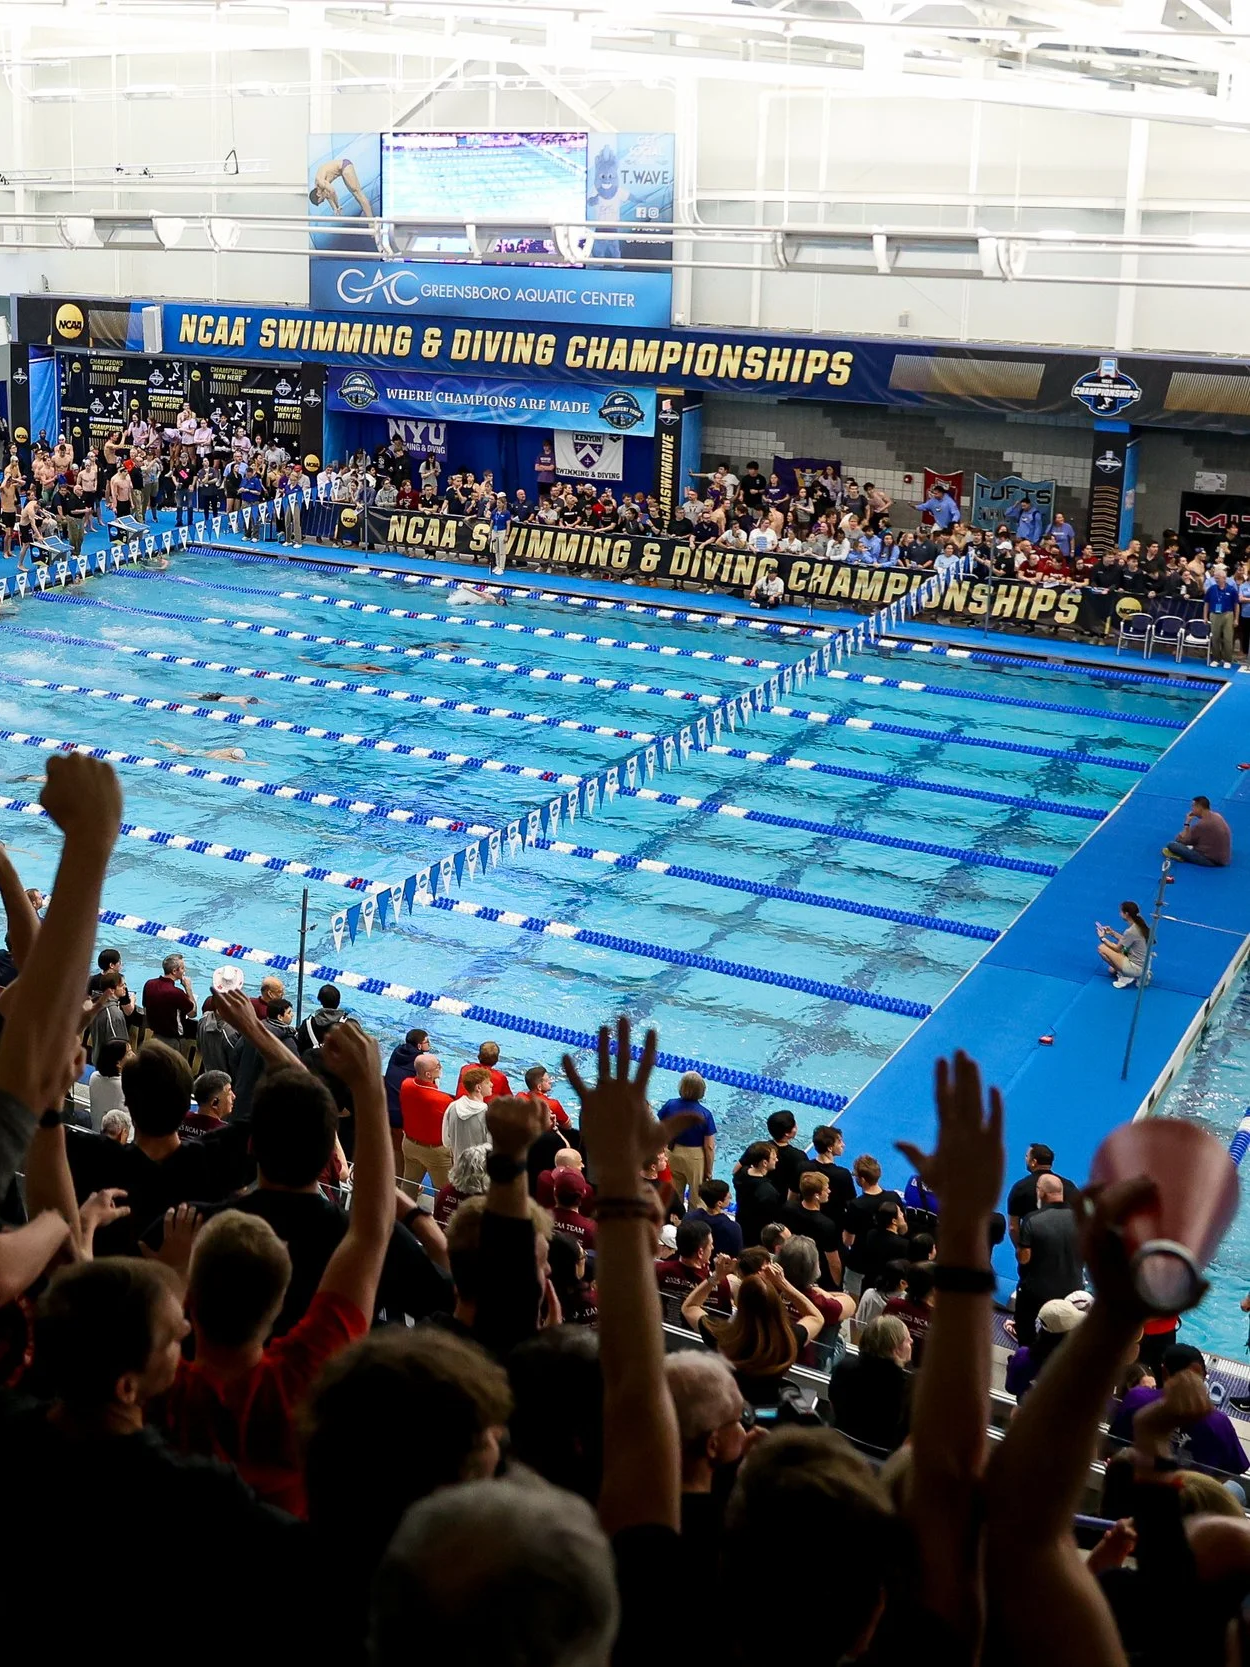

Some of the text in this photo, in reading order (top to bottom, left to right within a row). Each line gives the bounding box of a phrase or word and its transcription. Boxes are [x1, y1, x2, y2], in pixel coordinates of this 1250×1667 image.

[621, 171, 669, 185] T.WAVE
[337, 268, 419, 306] GAC
[421, 283, 635, 308] GREENSBORO AQUATIC CENTER
[58, 320, 83, 331] NCAA
[179, 313, 854, 387] NCAA SWIMMING & DIVING CHAMPIONSHIPS
[90, 358, 123, 367] CHAMPIONS
[92, 364, 120, 373] WIN HERE
[210, 366, 247, 376] CHAMPIONS
[213, 373, 243, 382] WIN HERE
[1074, 386, 1140, 399] CHAMPIONSHIPS
[148, 395, 184, 404] CHAMPIONS
[386, 387, 591, 414] WHERE CHAMPIONS ARE MADE
[164, 402, 180, 410] HERE
[89, 424, 124, 432] CHAMPIONS
[92, 429, 103, 437] WIN
[387, 417, 447, 446] NYU
[574, 433, 602, 443] KENYON
[556, 467, 590, 478] SWIMMING
[597, 472, 621, 480] DIVING
[976, 482, 1051, 504] TUFTS
[640, 542, 662, 572] &
[554, 1221, 585, 1235] CAA TEAM
[665, 1276, 681, 1285] 2025
